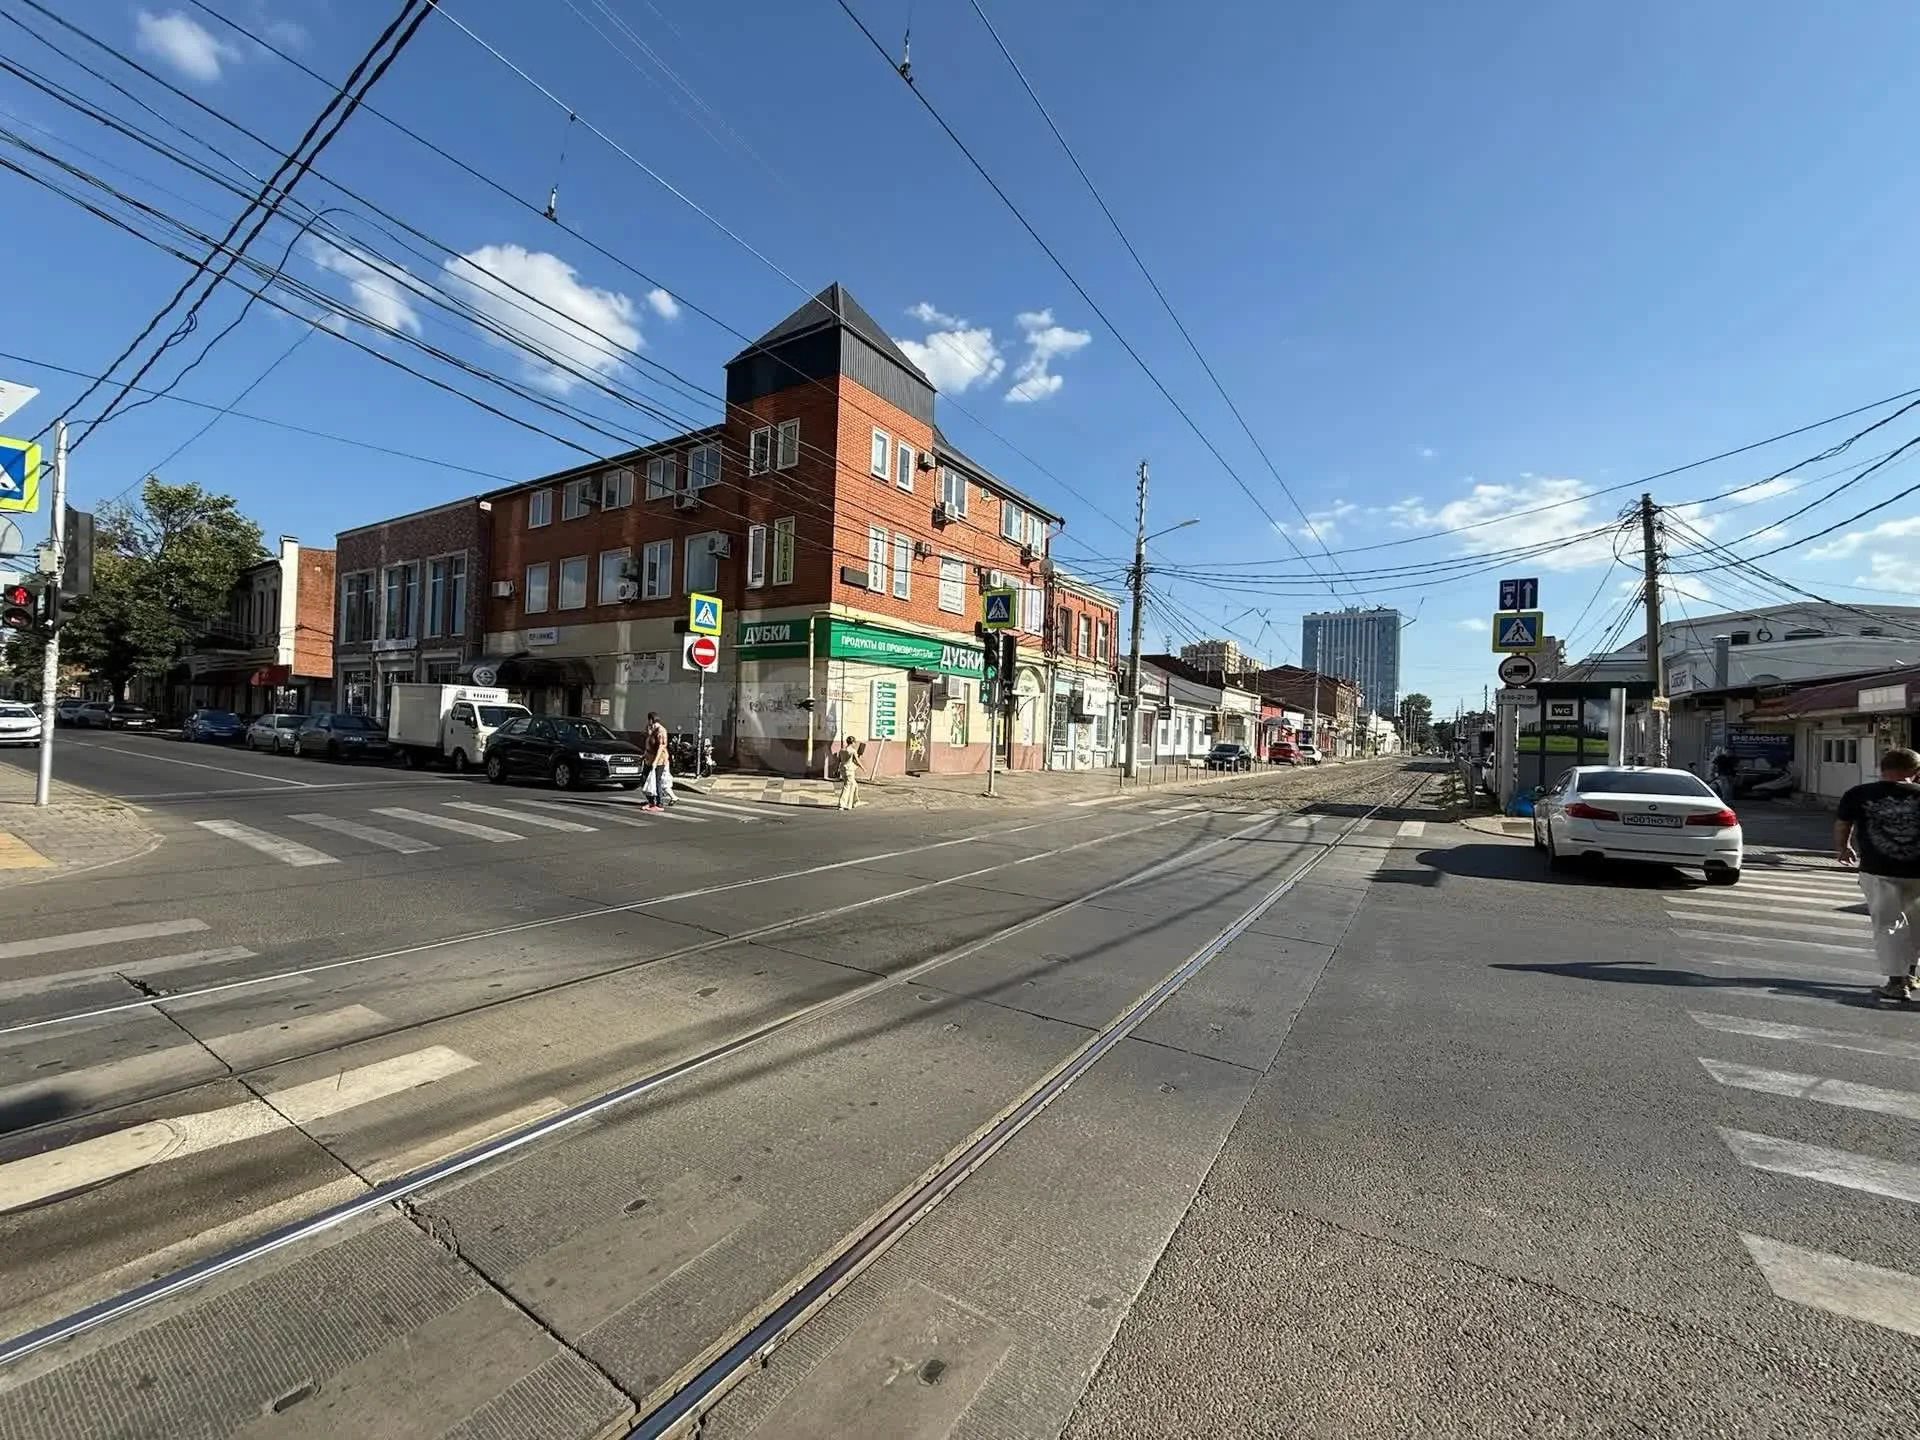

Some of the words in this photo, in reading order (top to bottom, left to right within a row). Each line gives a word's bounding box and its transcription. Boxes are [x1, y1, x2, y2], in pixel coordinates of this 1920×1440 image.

[744, 624, 790, 645] ДУБКИ
[841, 635, 877, 650] ПРОДУКТЫ
[878, 641, 886, 651] ОТ
[941, 645, 984, 671] ДУБКИ
[1732, 735, 1789, 743] РЕМОНТ
